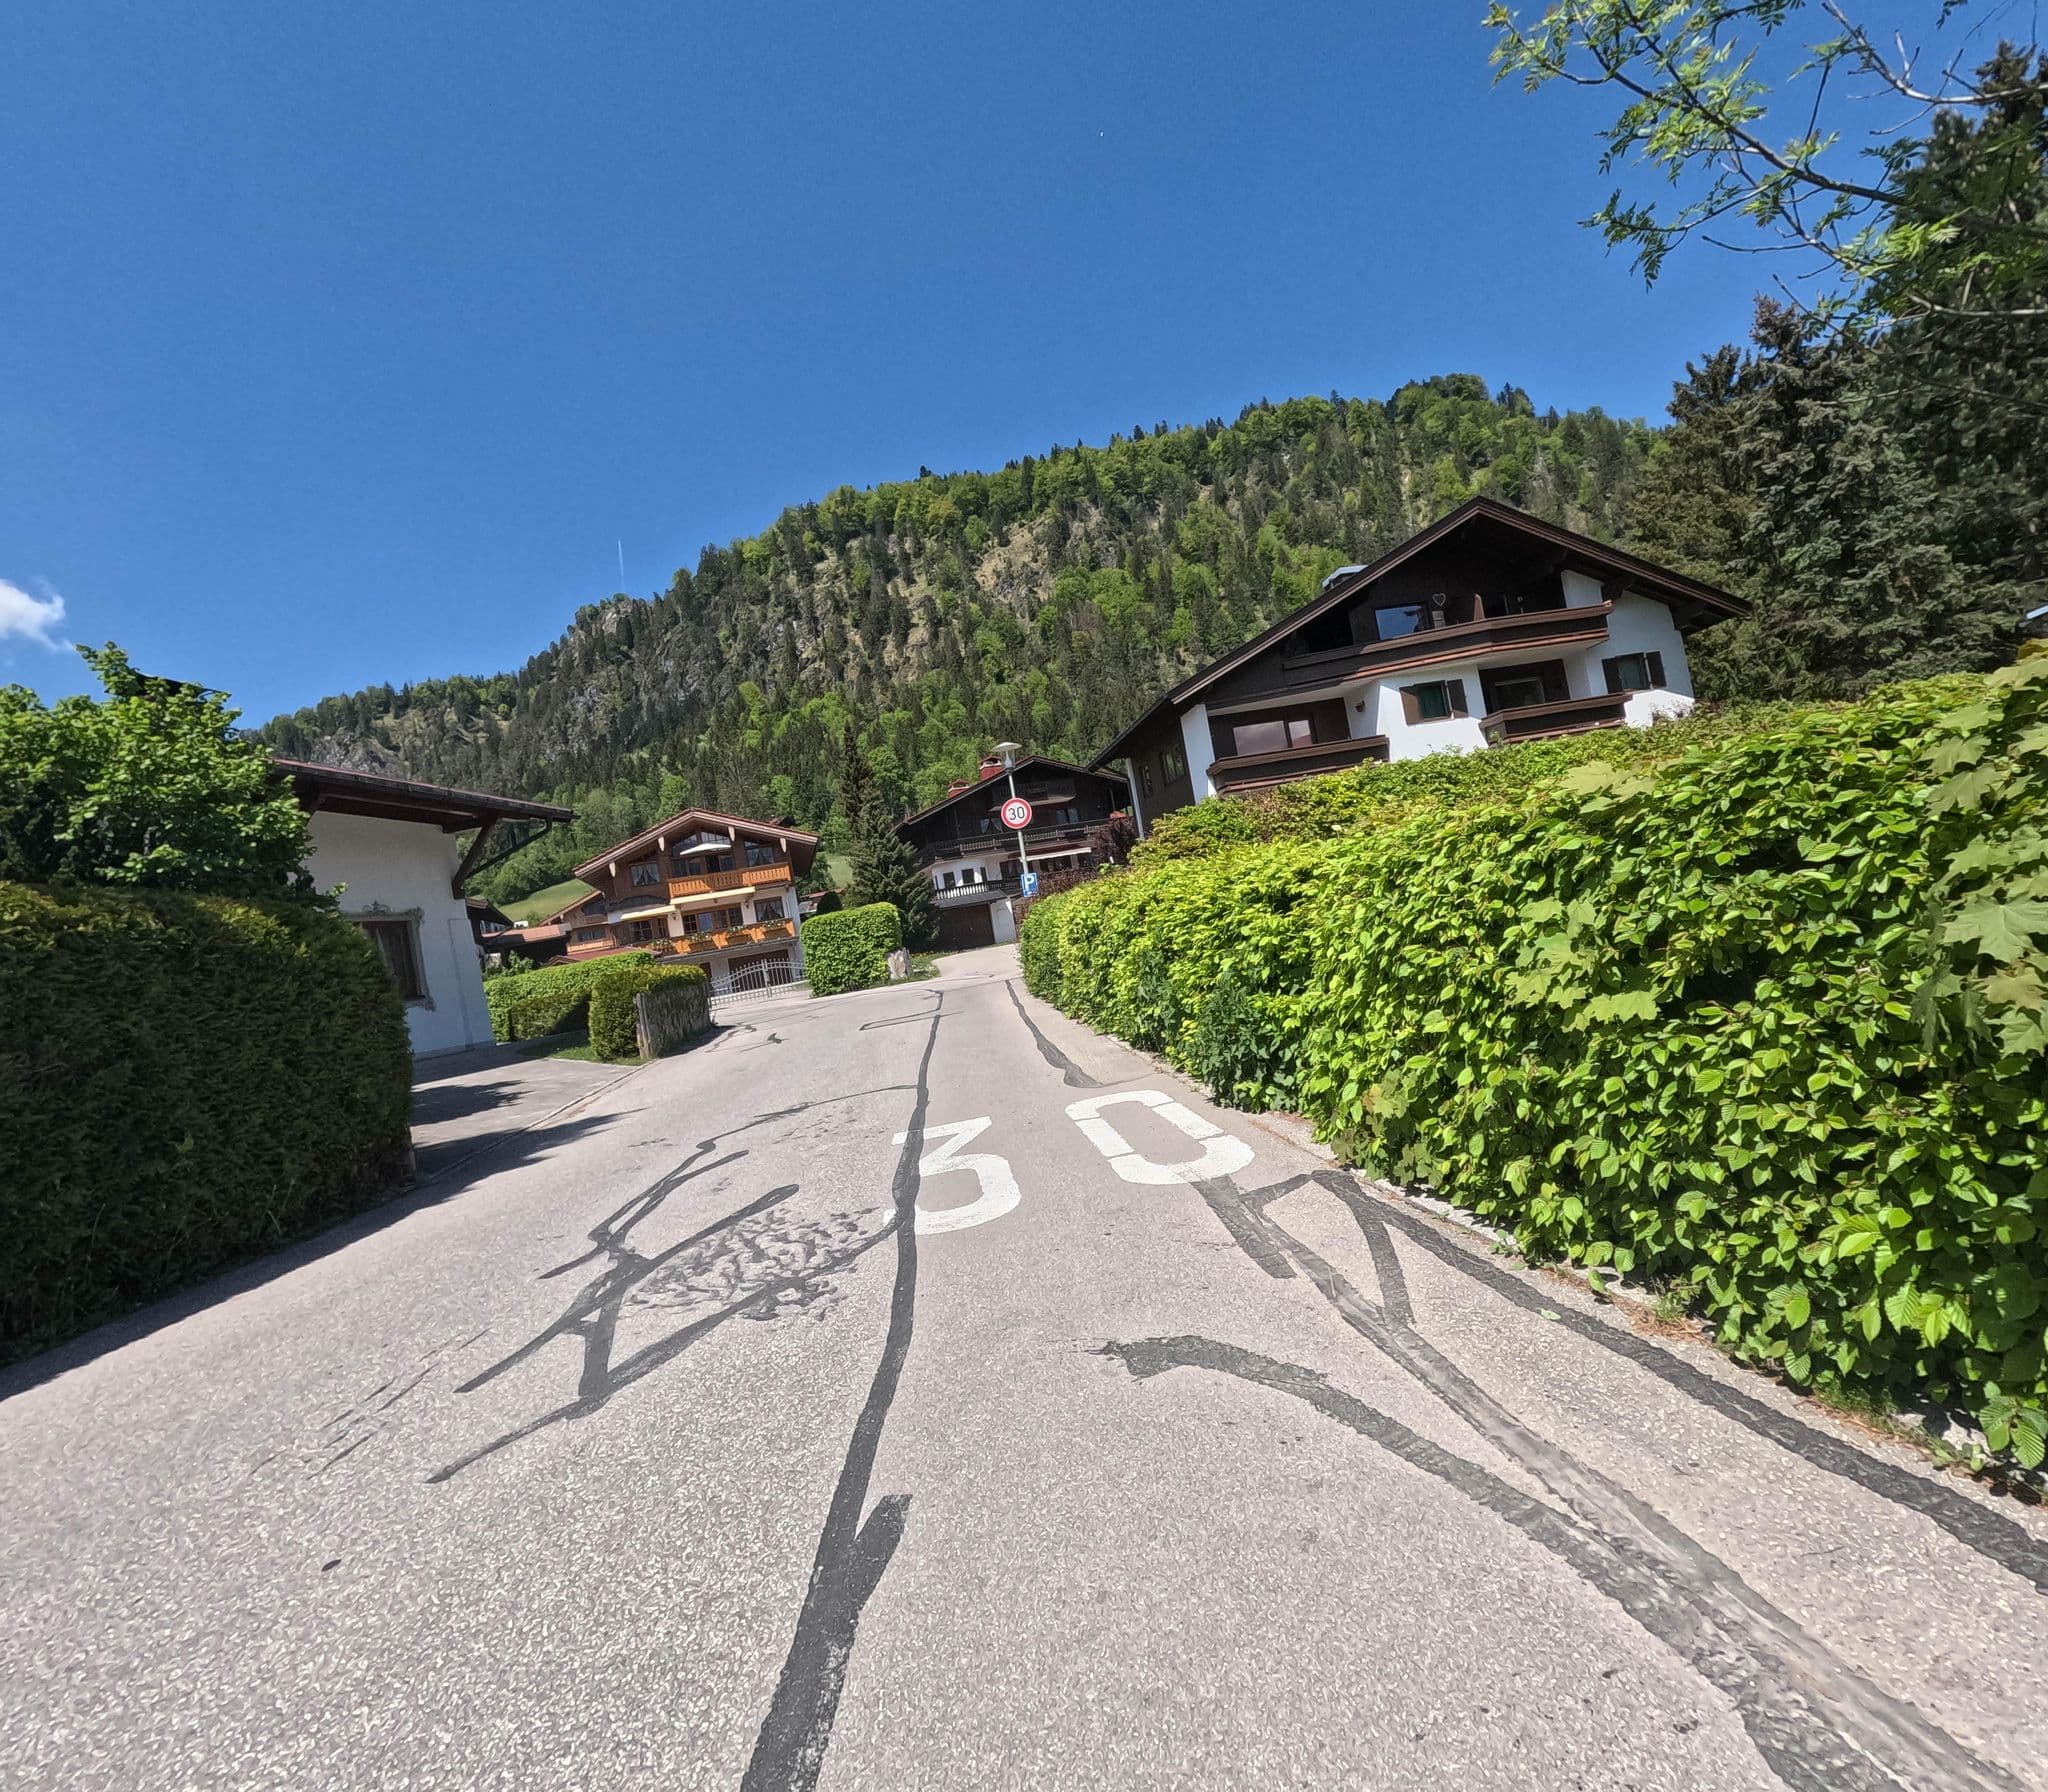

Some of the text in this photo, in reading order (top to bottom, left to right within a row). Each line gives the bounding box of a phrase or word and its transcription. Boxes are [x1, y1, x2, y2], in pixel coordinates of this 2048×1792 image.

[1008, 806, 1025, 821] 30
[1024, 875, 1035, 890] P
[883, 1089, 1255, 1235] 30
